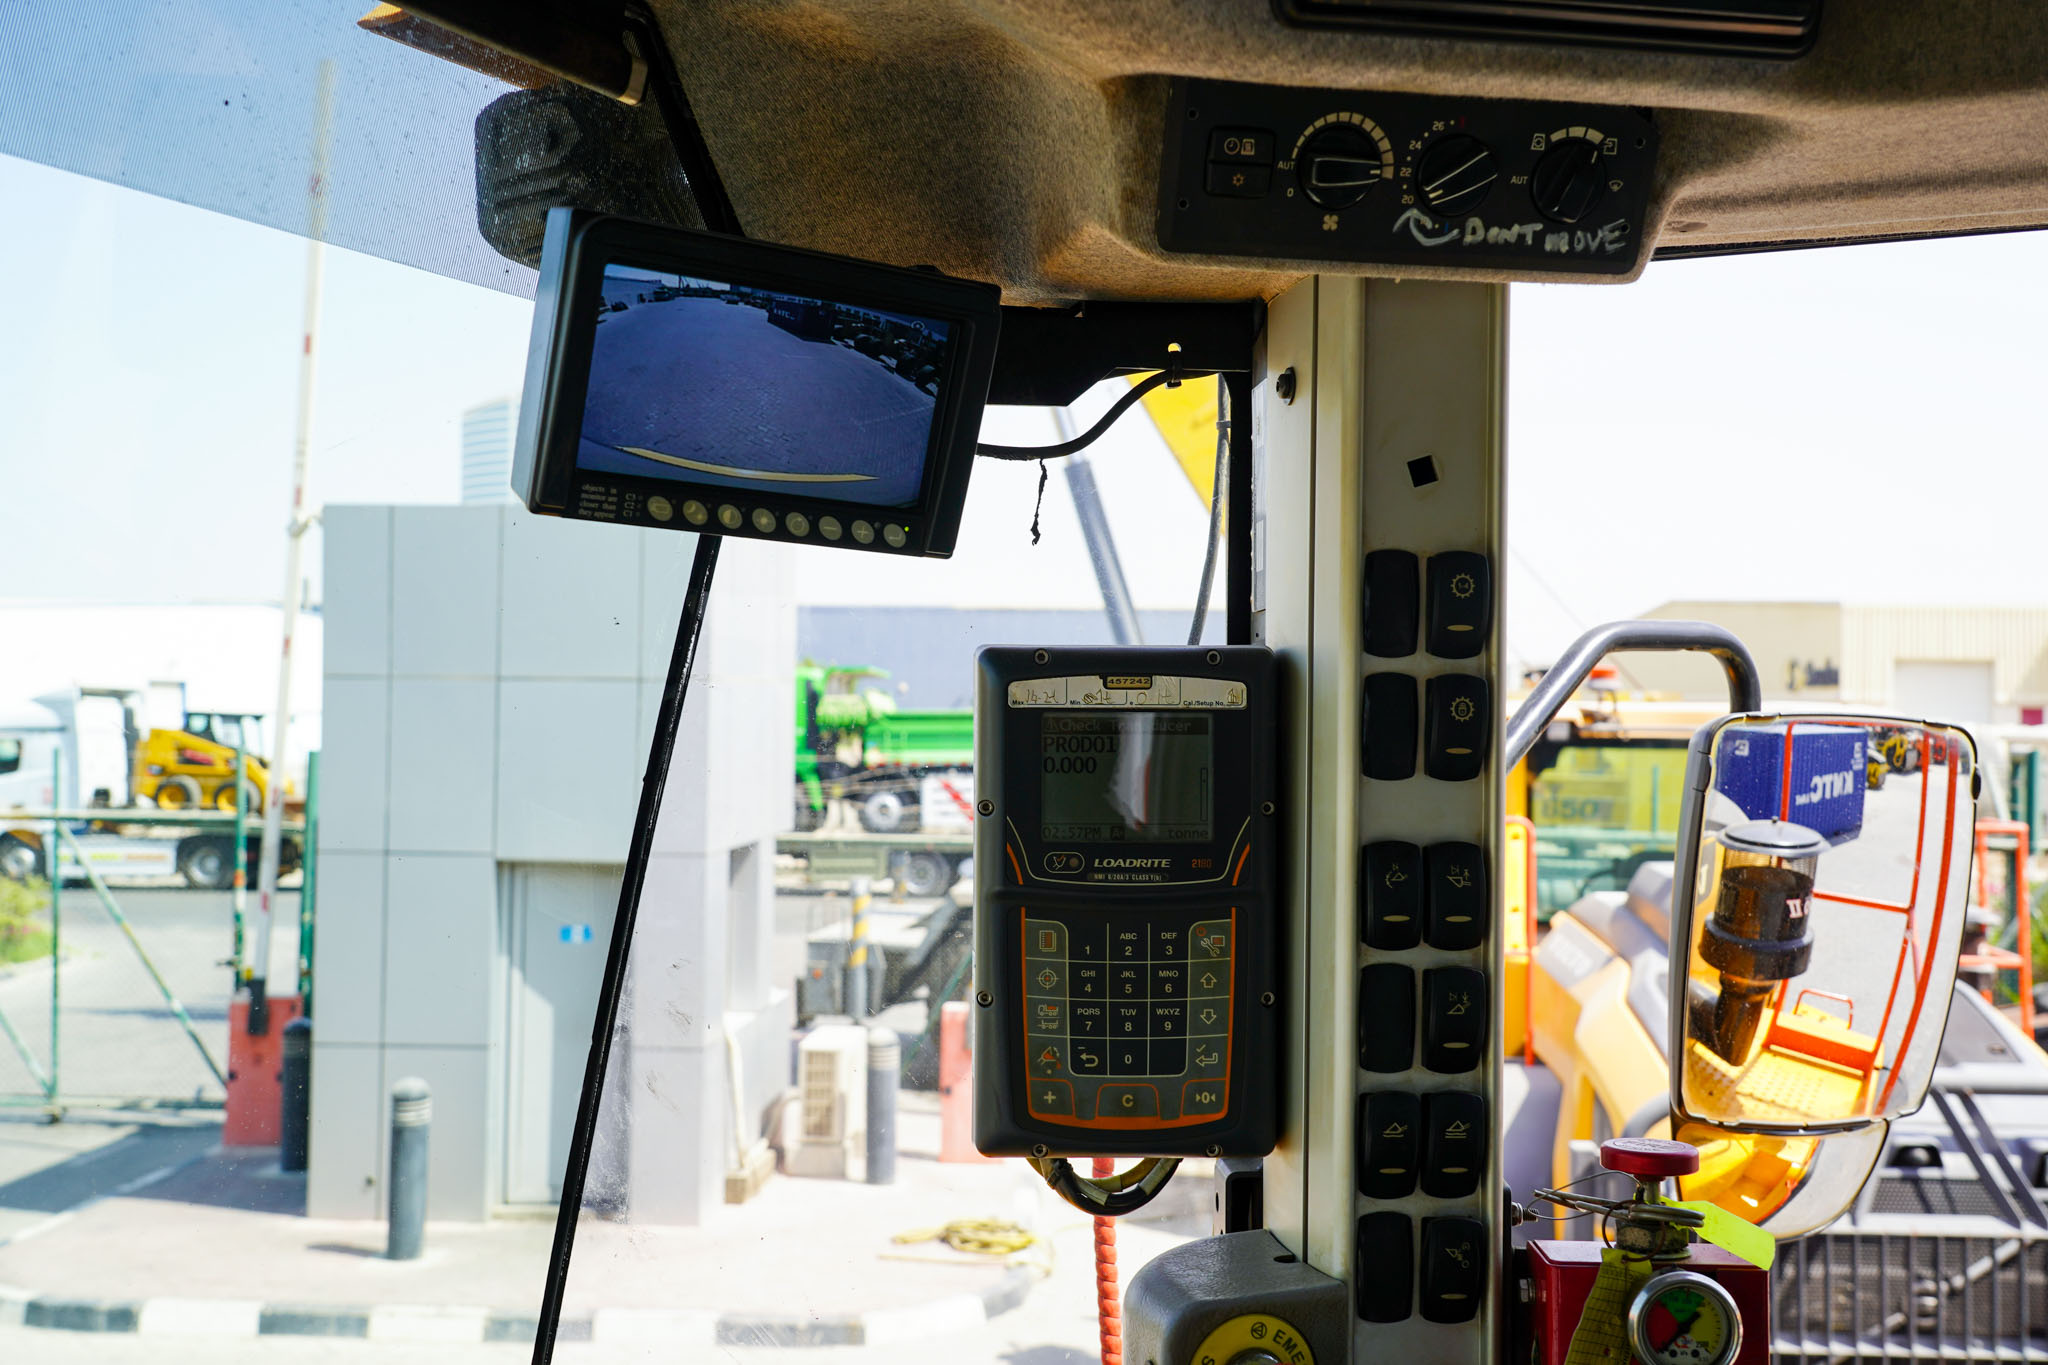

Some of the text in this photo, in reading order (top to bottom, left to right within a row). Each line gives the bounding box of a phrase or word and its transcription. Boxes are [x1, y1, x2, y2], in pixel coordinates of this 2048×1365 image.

[1432, 121, 1445, 131] 26
[1409, 140, 1422, 150] 24
[1277, 160, 1296, 170] AUT
[1400, 167, 1412, 177] 22
[1510, 175, 1528, 185] AUT
[1401, 194, 1415, 205] 20
[1107, 678, 1151, 686] 457242
[1043, 756, 1097, 774] 0.000
[1043, 827, 1102, 839] 02:57PM
[1168, 827, 1208, 839] tonne
[1094, 858, 1171, 868] LOADRITE
[1120, 932, 1137, 940] ABC
[1161, 932, 1177, 940] DEF
[1085, 946, 1091, 955] 1
[1125, 946, 1132, 955] 2
[1165, 946, 1173, 955] 3
[1081, 970, 1096, 978] GHI
[1120, 970, 1136, 978] JKL
[1158, 969, 1178, 978] MNO
[1084, 983, 1092, 993] 4
[1125, 984, 1132, 993] 5
[1165, 984, 1172, 993] 6
[1077, 1007, 1100, 1016] PQRS
[1120, 1008, 1137, 1016] TUV
[1156, 1007, 1180, 1015] WXYZ
[1085, 1022, 1093, 1031] 7
[1124, 1022, 1132, 1031] 8
[1164, 1021, 1172, 1031] 9
[1124, 1055, 1132, 1064] 0
[1122, 1094, 1134, 1107] C
[1273, 1329, 1306, 1365] EME
